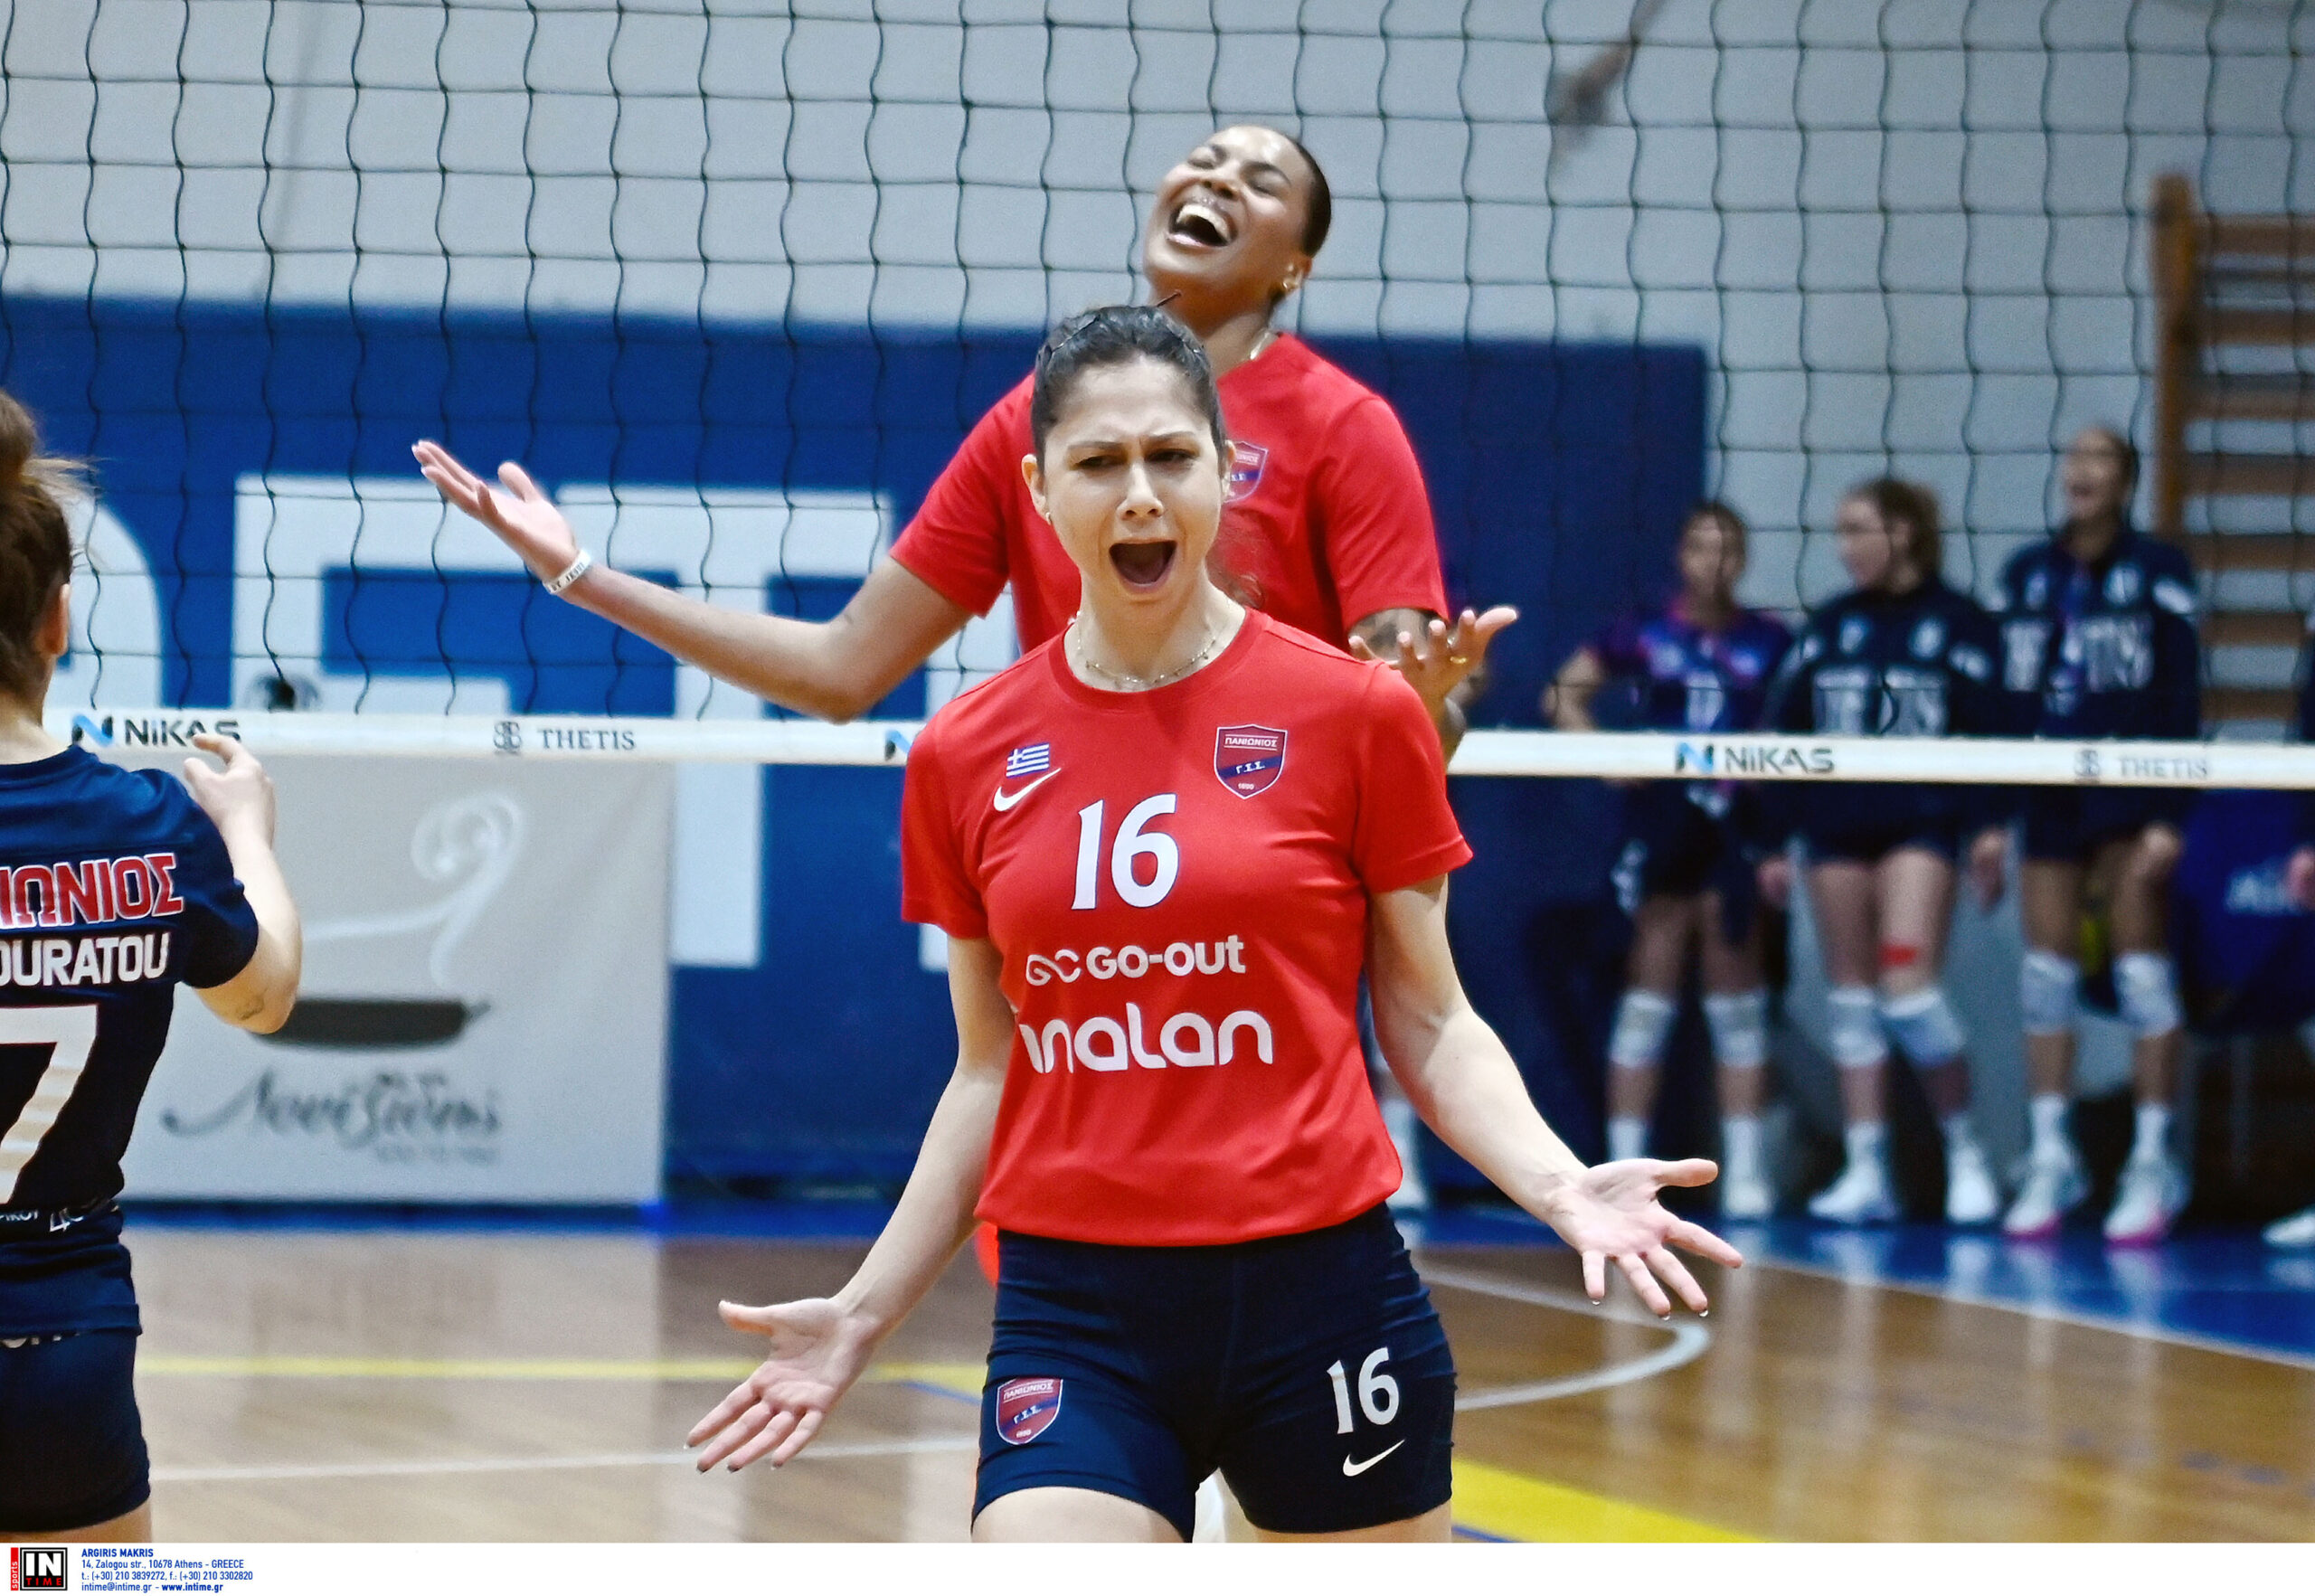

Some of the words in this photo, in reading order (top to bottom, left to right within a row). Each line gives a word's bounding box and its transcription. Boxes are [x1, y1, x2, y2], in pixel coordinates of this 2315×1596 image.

[537, 728, 637, 751] THETIS
[1071, 792, 1179, 911] 16
[1327, 1346, 1400, 1435] 16
